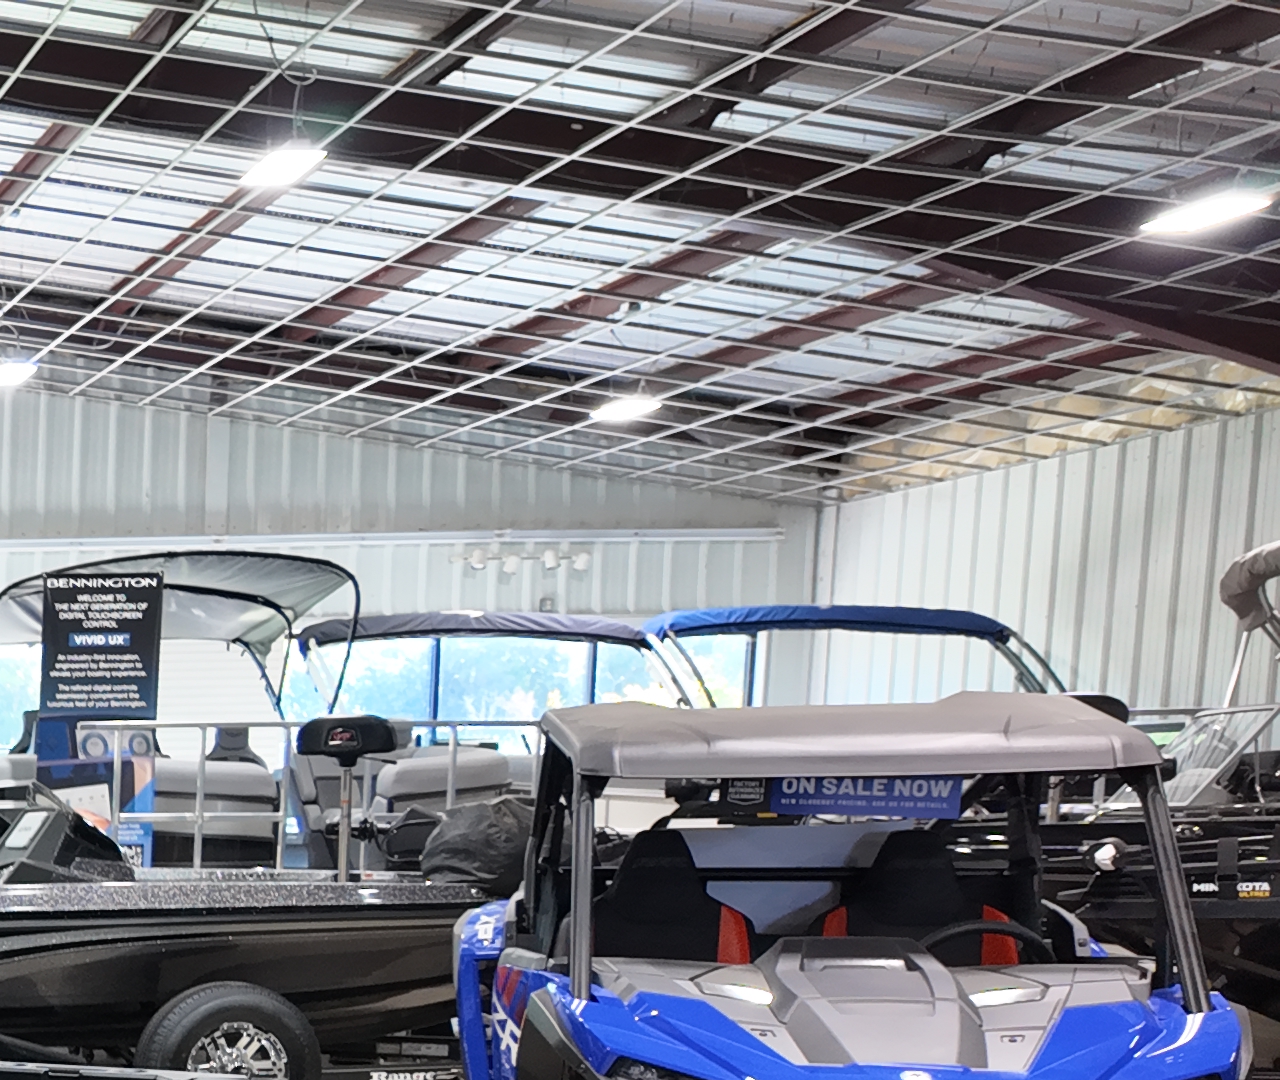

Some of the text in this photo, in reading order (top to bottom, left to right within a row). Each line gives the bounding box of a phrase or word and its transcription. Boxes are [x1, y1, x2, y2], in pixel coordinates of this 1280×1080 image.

[46, 577, 158, 589] BENNINGTON
[77, 593, 127, 602] WELCOME TO
[54, 602, 149, 611] THE NEXT GENERATION OF
[82, 620, 119, 629] CONTROL
[74, 634, 106, 645] VIVID
[782, 777, 954, 799] ON SALE NOW
